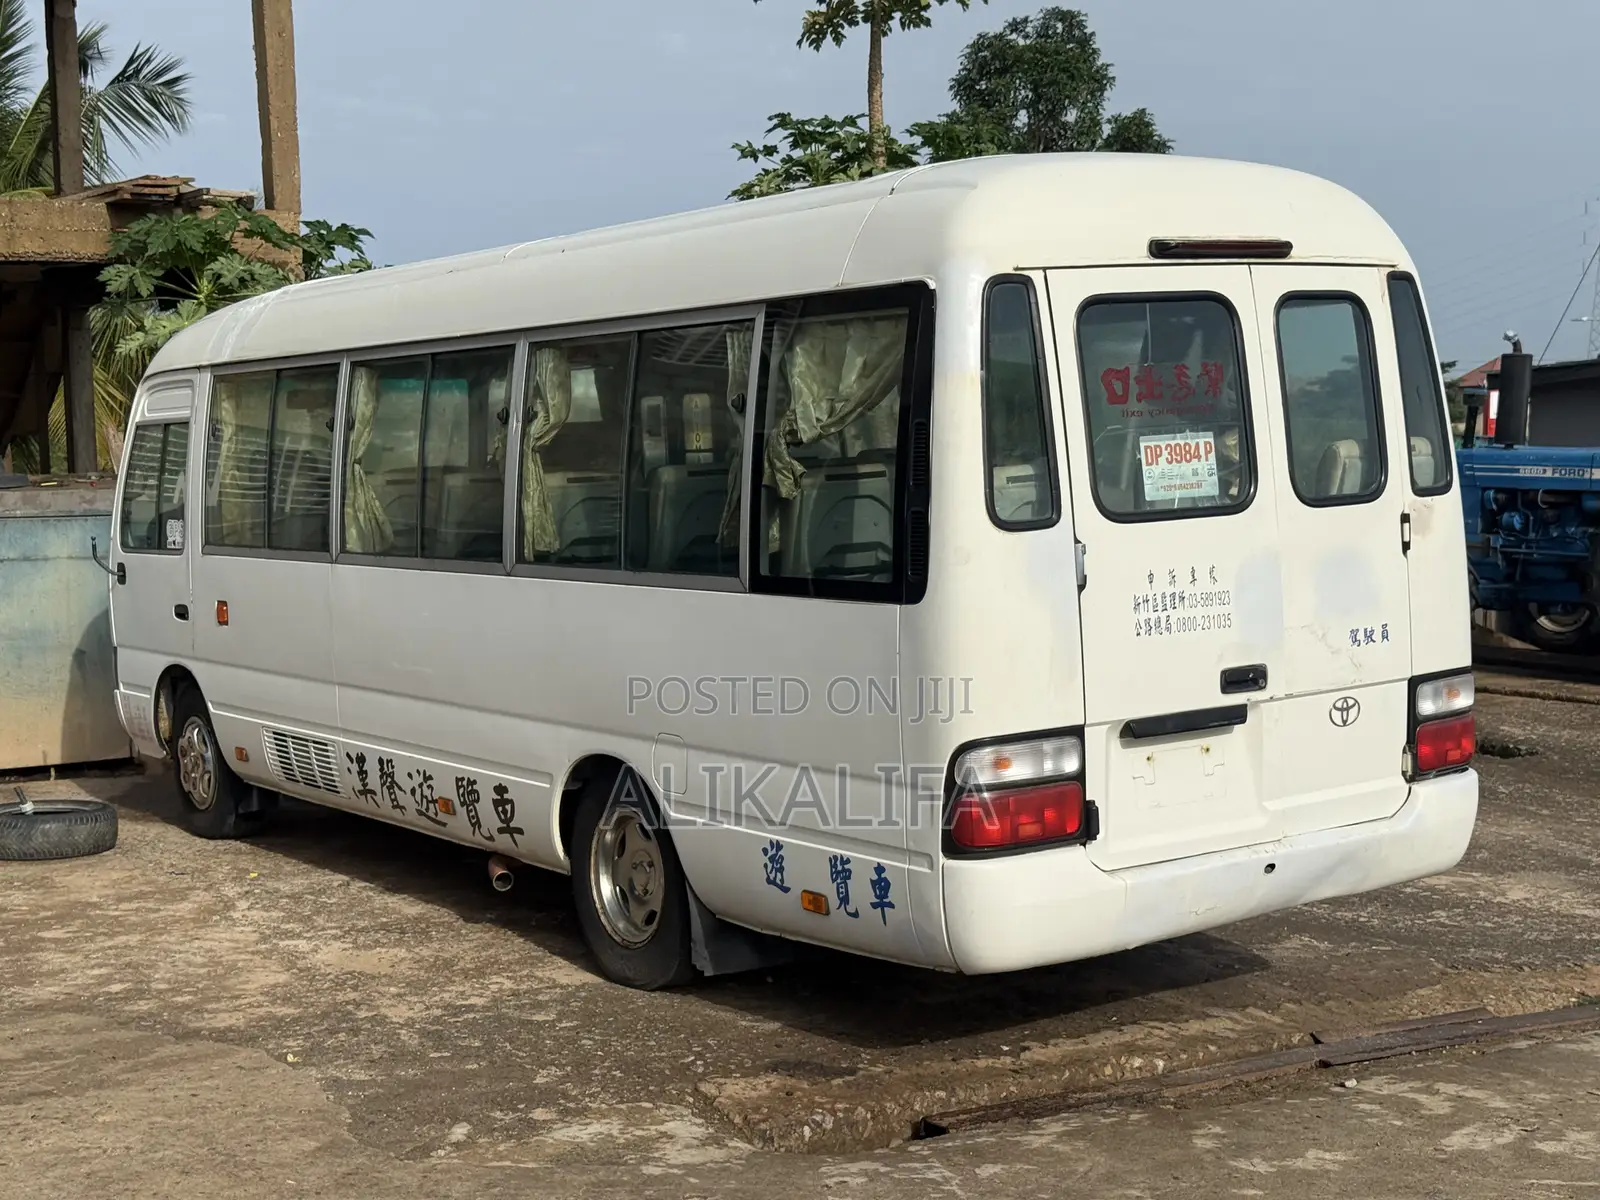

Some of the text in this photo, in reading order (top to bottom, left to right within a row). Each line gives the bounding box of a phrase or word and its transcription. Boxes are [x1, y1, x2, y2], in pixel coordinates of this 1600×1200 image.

[1143, 440, 1214, 467] DP 3984 P
[1551, 467, 1585, 478] FORD
[1349, 623, 1390, 647] 駕駛員
